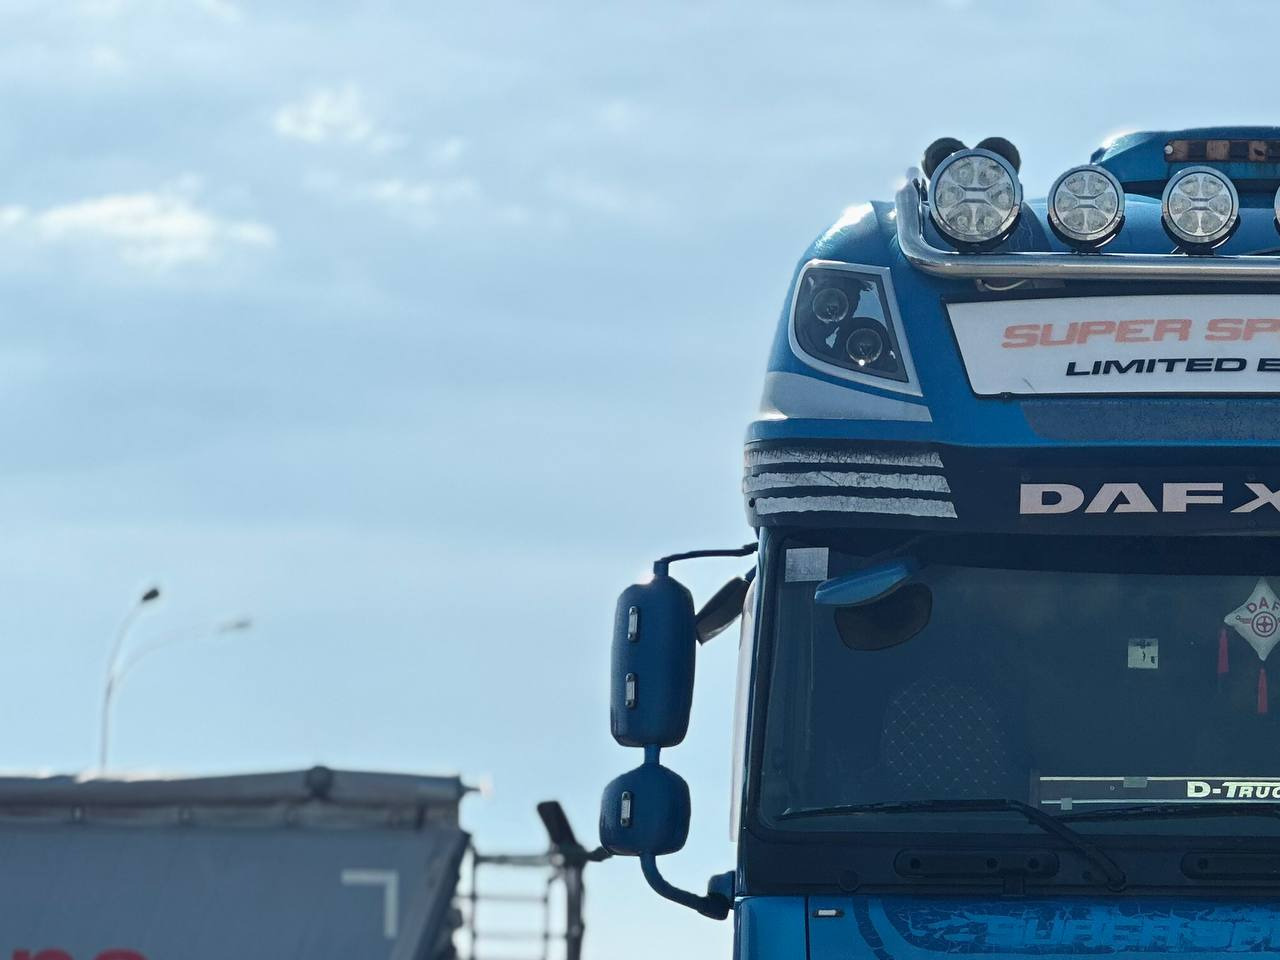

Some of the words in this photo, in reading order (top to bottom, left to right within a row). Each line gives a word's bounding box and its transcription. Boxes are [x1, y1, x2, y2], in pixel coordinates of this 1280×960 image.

[1001, 319, 1193, 349] SUPER
[1066, 358, 1248, 376] LIMITED
[1019, 483, 1224, 514] DAF
[1246, 596, 1280, 613] DAF
